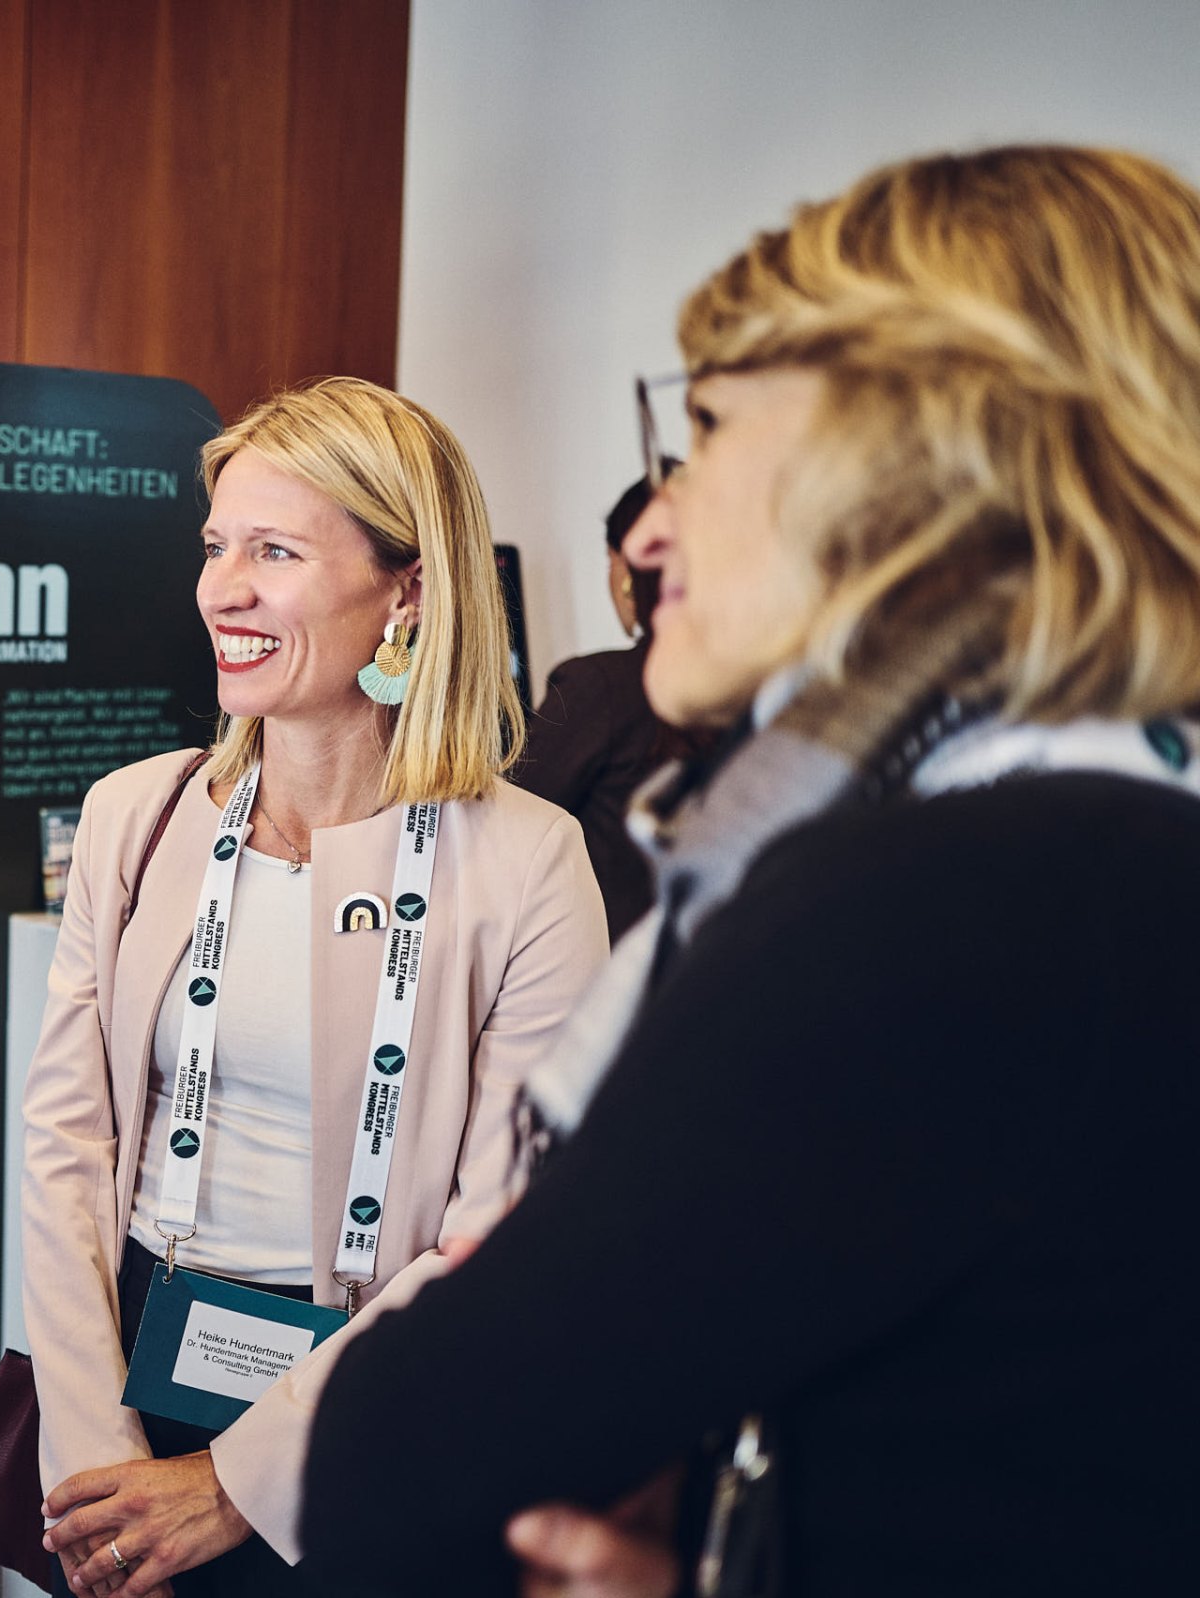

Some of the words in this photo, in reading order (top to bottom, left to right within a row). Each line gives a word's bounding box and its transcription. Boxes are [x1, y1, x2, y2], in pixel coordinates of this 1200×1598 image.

[406, 803, 418, 833] GRESS
[192, 916, 206, 968] FREIBURGER
[201, 899, 218, 969] MITTELSTANDS
[211, 921, 225, 970] KONGRESS
[386, 928, 402, 978] KONGRESS
[408, 930, 422, 983] FREIBURGER
[394, 928, 413, 1001] MITTELSTANDS
[174, 1066, 187, 1119] FREIBURGER
[184, 1048, 200, 1120] MITTELSTANDS
[194, 1071, 207, 1122] KONGRESS
[363, 1081, 380, 1133] KONGRESS
[371, 1083, 390, 1156] MITTELSTANDS
[385, 1085, 400, 1138] FREIBURGER
[355, 1232, 366, 1251] MIT
[186, 1338, 198, 1348] Dr.
[200, 1342, 248, 1361] Hundertmark
[197, 1330, 227, 1345] Heike
[229, 1337, 295, 1362] Hundertmark
[203, 1353, 210, 1361] &
[211, 1355, 252, 1373] Consulting
[253, 1366, 279, 1378] GmbH
